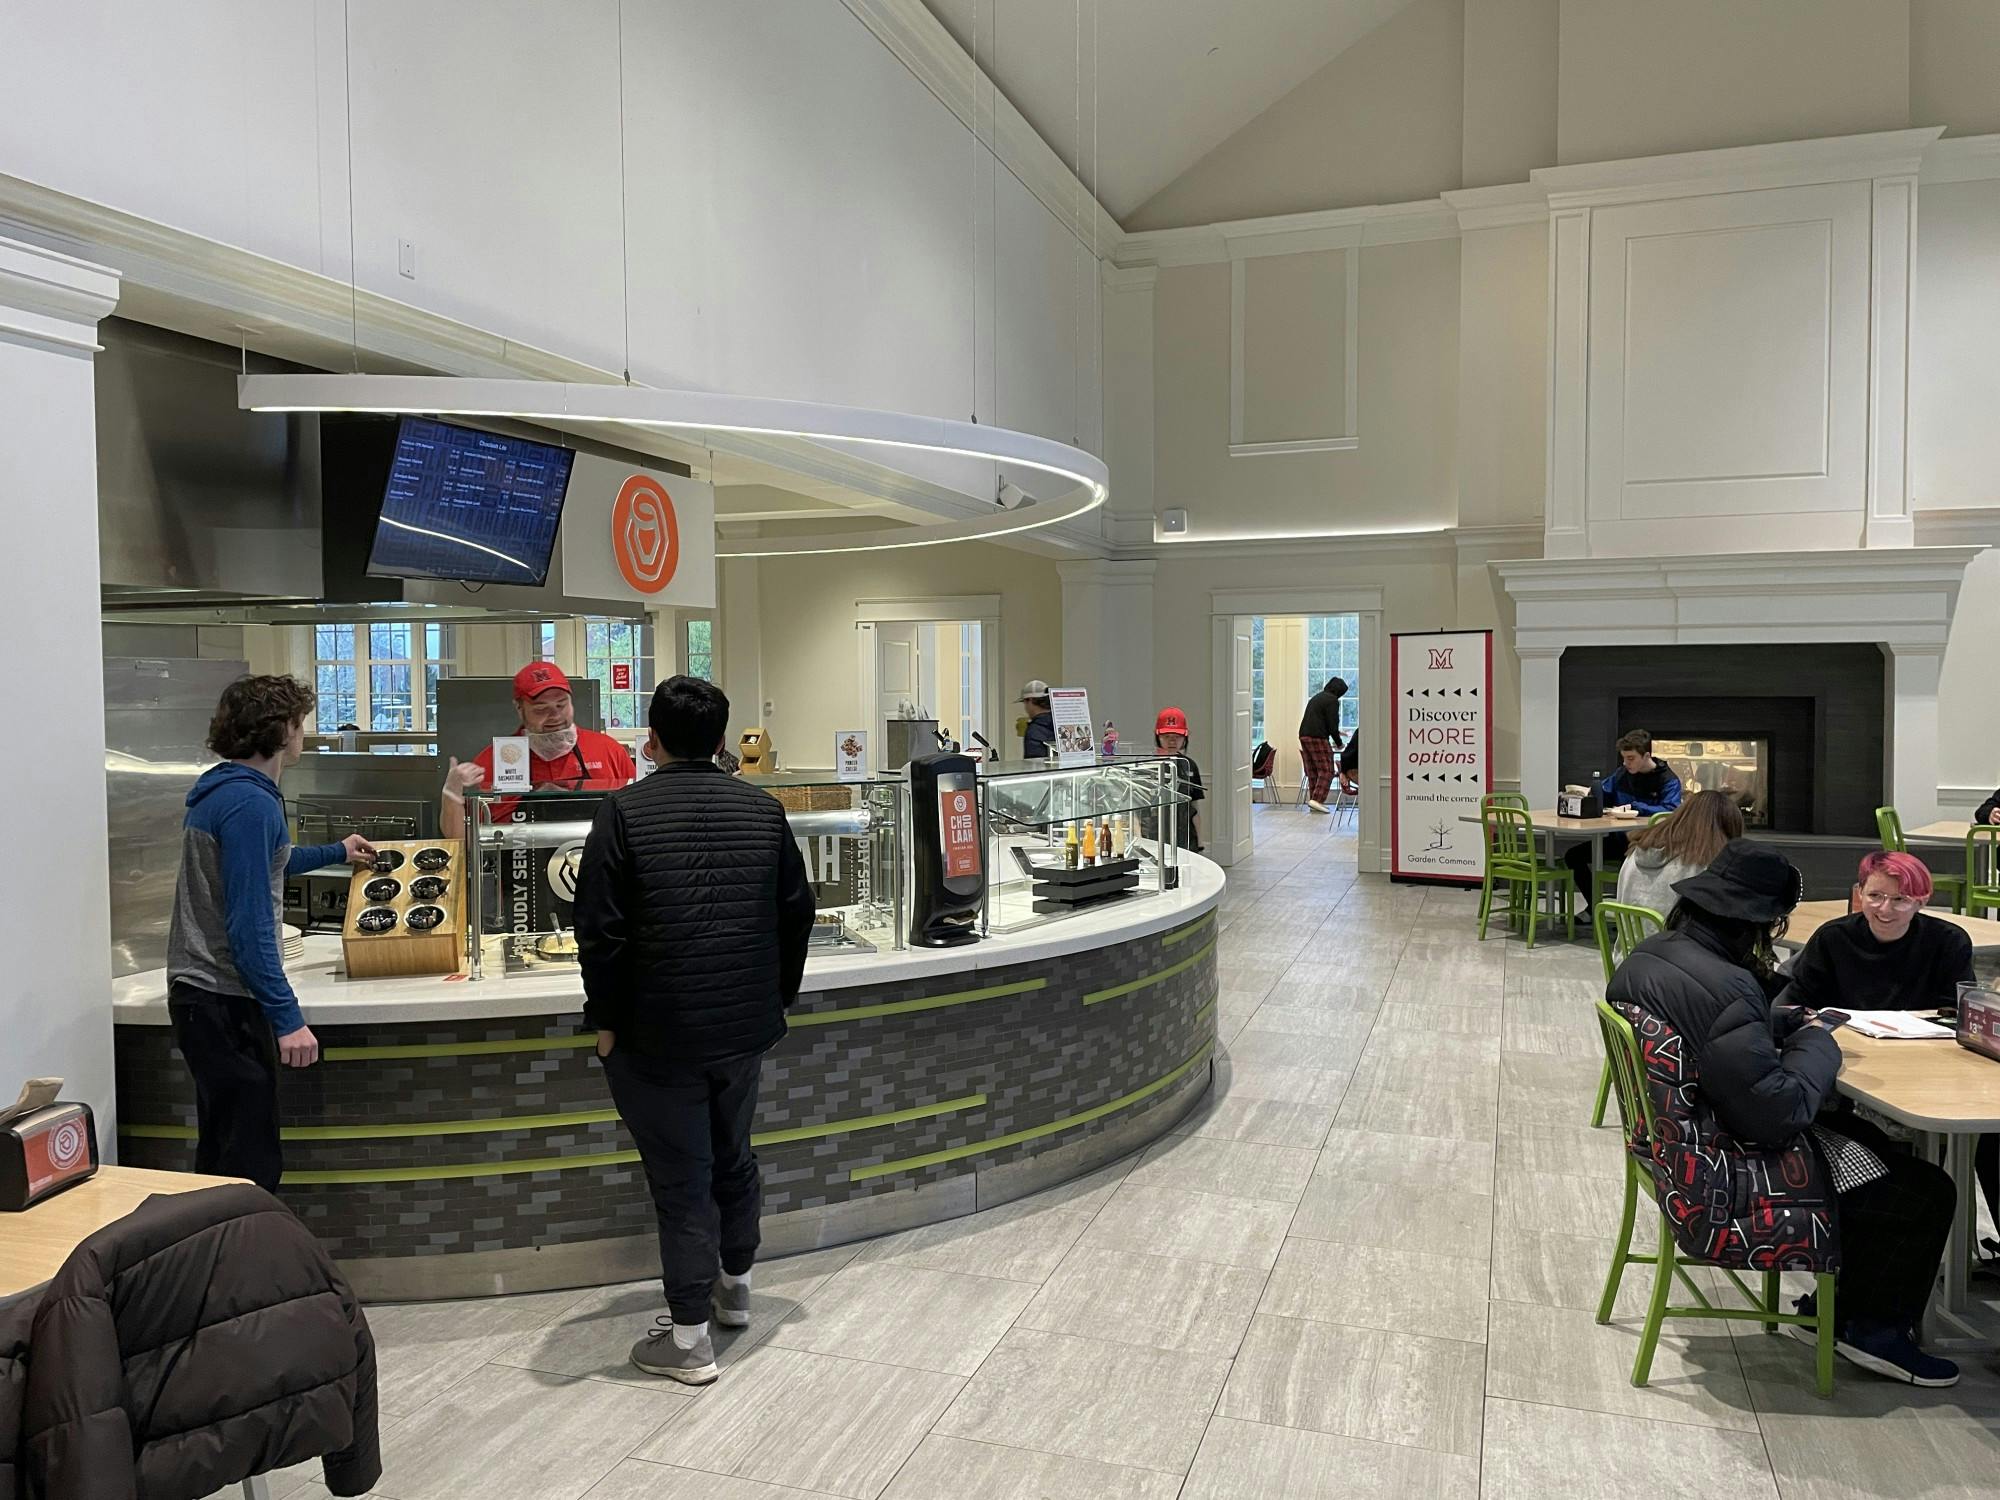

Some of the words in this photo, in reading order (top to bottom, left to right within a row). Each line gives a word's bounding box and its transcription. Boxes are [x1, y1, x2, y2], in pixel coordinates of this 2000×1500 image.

[1428, 648, 1454, 670] M
[1409, 707, 1478, 722] Discover
[1409, 728, 1476, 745] MORE
[1408, 749, 1476, 766] options
[1405, 793, 1435, 802] around
[1436, 793, 1450, 803] the
[951, 828, 974, 844] LAAH
[511, 811, 528, 880] SERVING
[1407, 854, 1436, 864] Garden
[1438, 856, 1476, 866] Commons
[513, 884, 529, 957] PROUDLY
